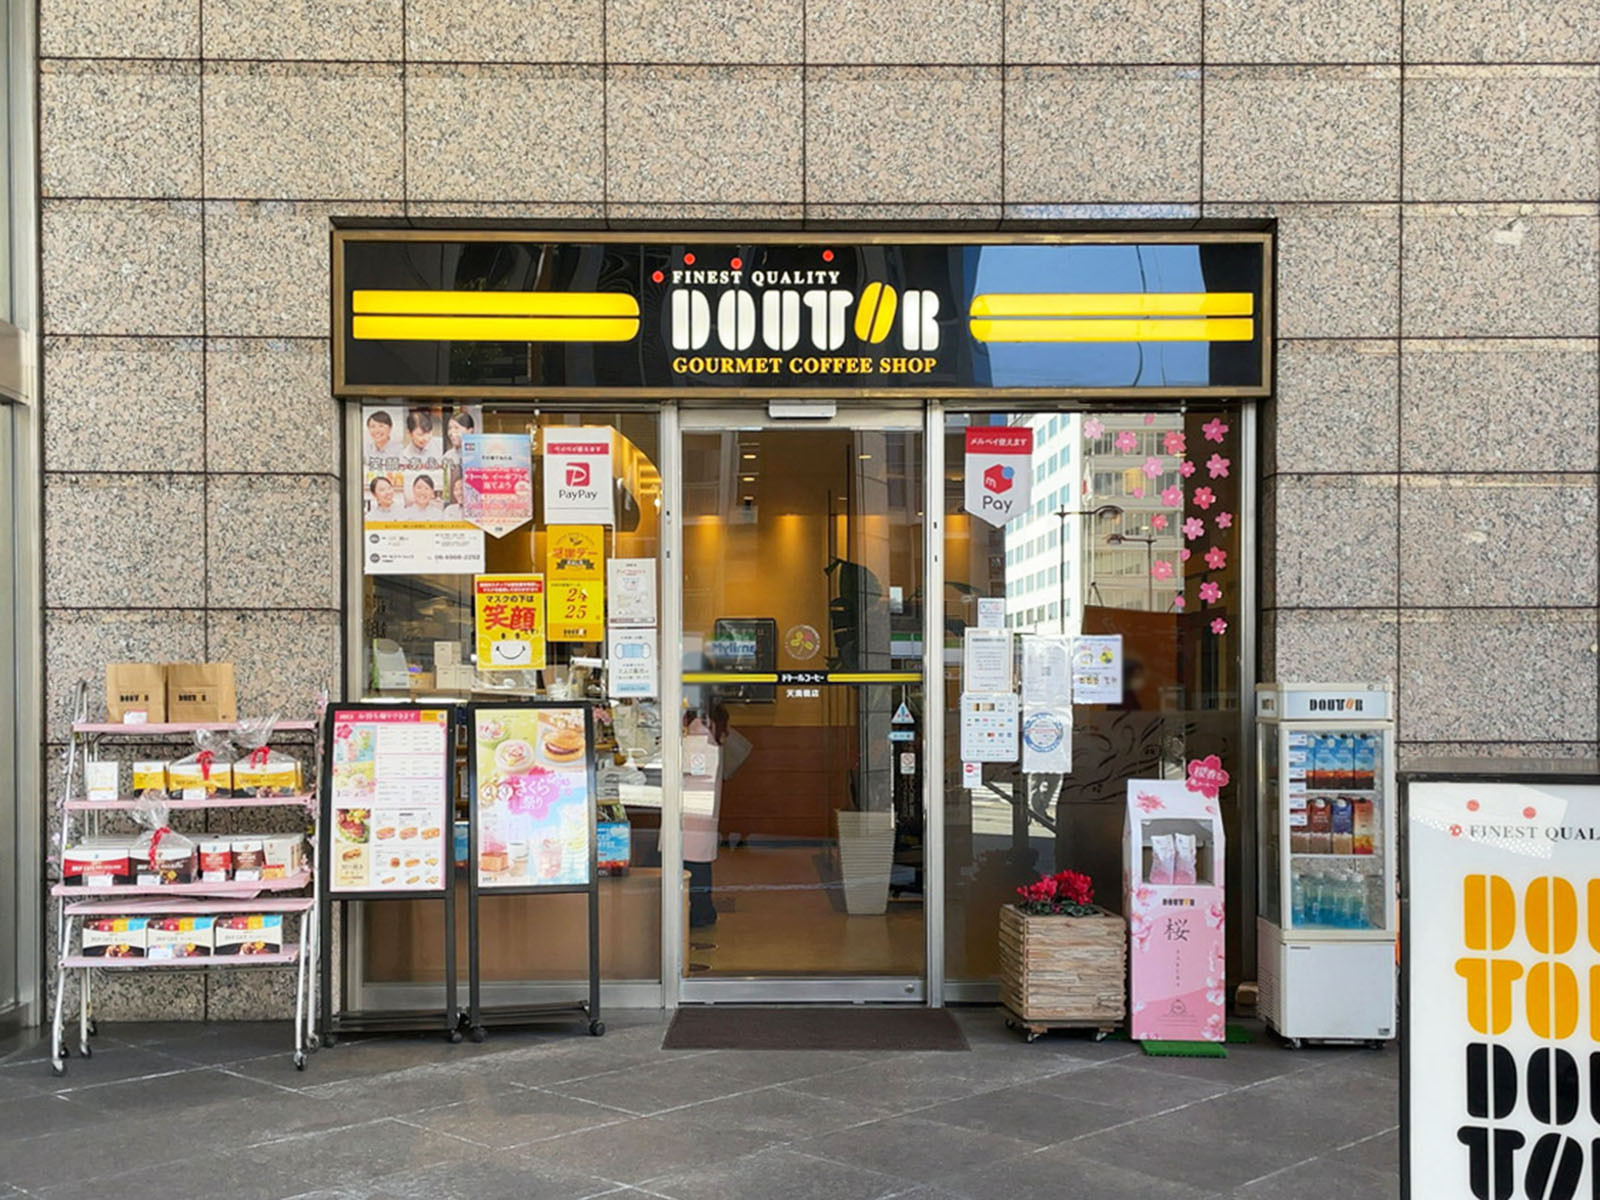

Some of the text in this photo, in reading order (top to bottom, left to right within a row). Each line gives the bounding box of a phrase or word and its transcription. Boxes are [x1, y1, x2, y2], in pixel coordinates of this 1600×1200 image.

[672, 271, 840, 287] FINEST QUALITY
[672, 281, 940, 351] DOUTOR
[672, 357, 937, 374] GOURMET COFFEE SHOP
[558, 489, 598, 501] PayPay
[982, 495, 1013, 513] Pay
[486, 595, 534, 603] マスクの下は
[483, 604, 536, 631] 笑顔
[564, 604, 588, 620] 25
[1309, 698, 1363, 711] DOUTOR
[1469, 824, 1538, 839] FINEST
[1464, 873, 1600, 955] DO
[1164, 918, 1190, 941] 桜
[1454, 957, 1600, 1042] TO
[1466, 1042, 1600, 1126] DO
[1457, 1125, 1600, 1200] TO
